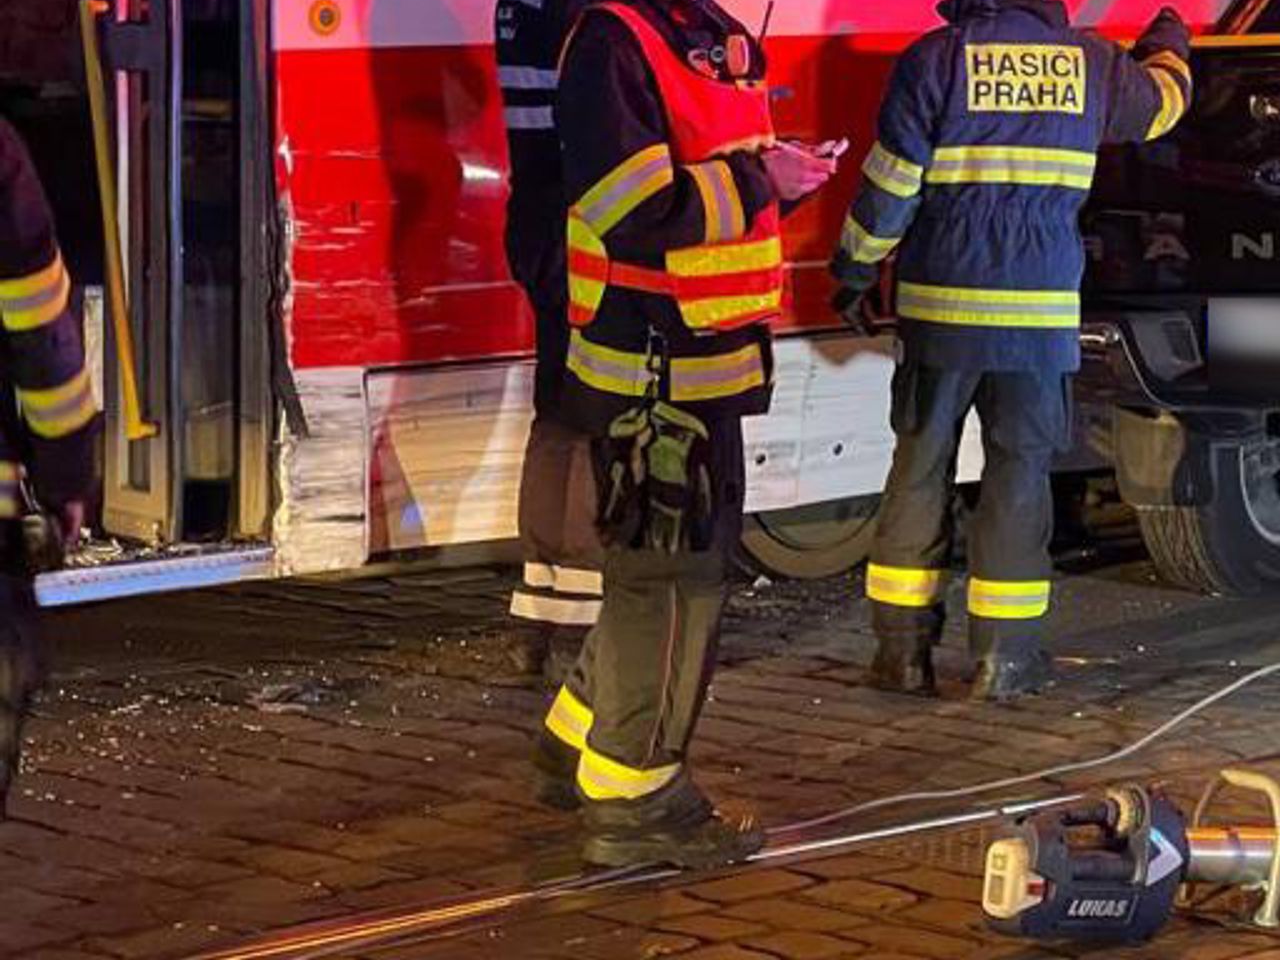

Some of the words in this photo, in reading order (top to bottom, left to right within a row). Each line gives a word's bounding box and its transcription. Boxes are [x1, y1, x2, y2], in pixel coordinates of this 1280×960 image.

[972, 49, 1080, 78] HASIČI
[974, 81, 1079, 107] PRAHA
[1067, 899, 1128, 917] LUKAS
